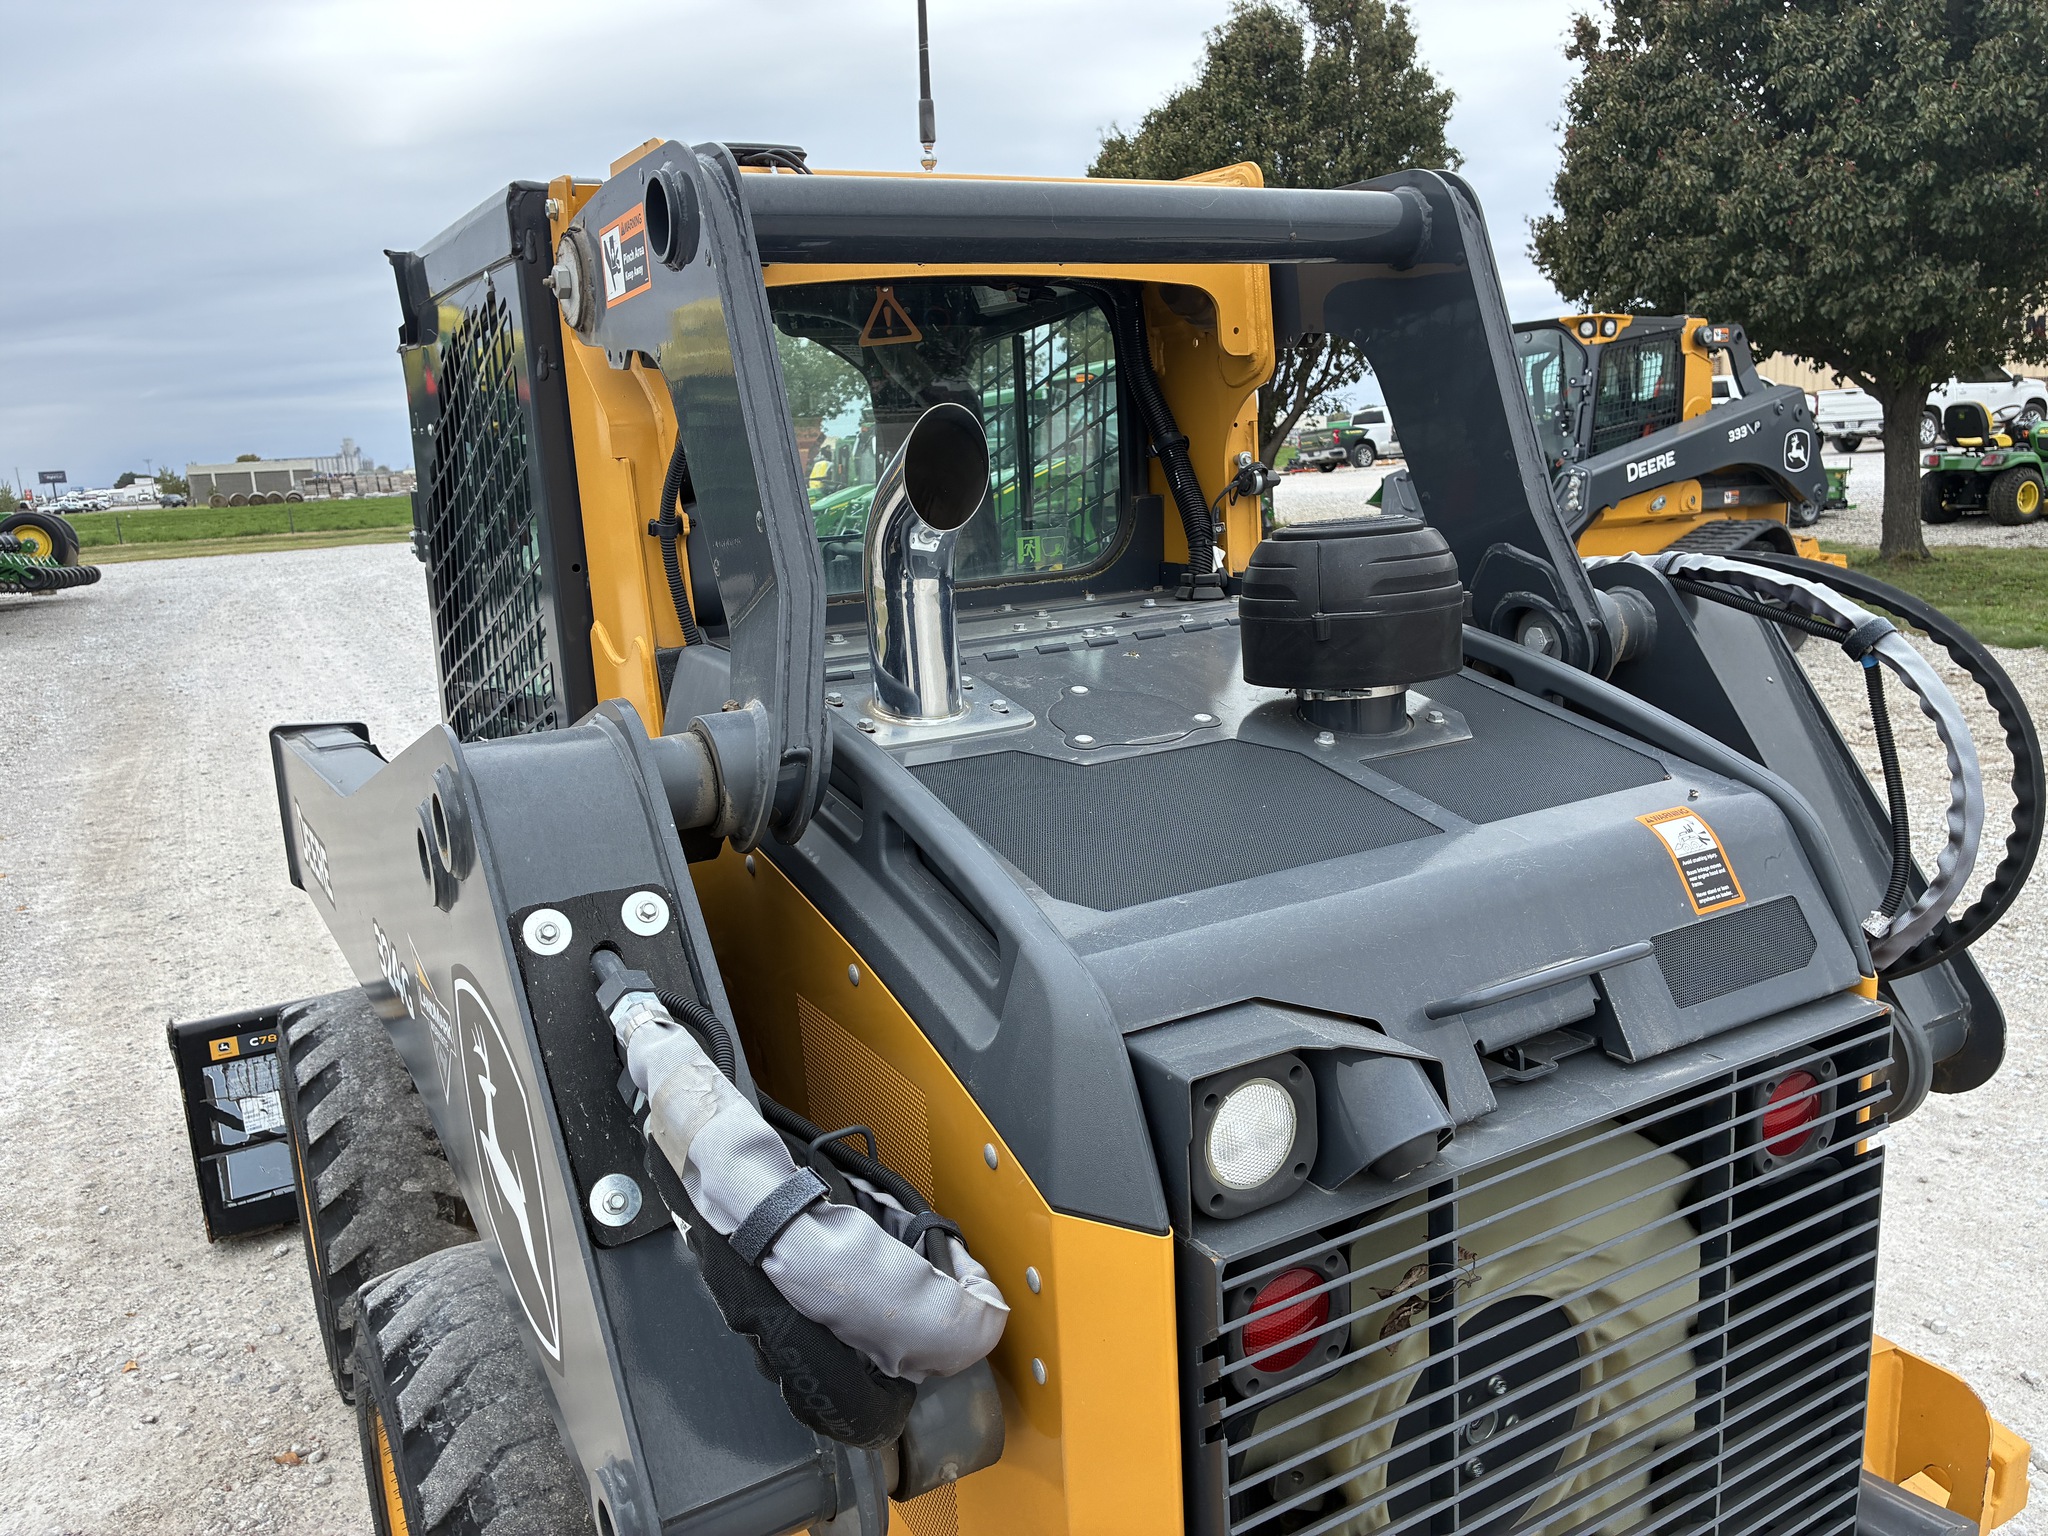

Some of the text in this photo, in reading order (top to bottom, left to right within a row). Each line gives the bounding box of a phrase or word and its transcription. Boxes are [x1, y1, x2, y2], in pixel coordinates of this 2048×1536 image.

[624, 213, 642, 232] WARNING
[623, 246, 645, 265] Pinch Area
[625, 270, 634, 281] Keep
[633, 265, 644, 276] Away
[1626, 450, 1676, 483] DEERE
[1652, 809, 1689, 821] WARNING
[294, 799, 336, 907] DEERE
[373, 920, 415, 1021] 324G
[249, 1033, 278, 1047] C78
